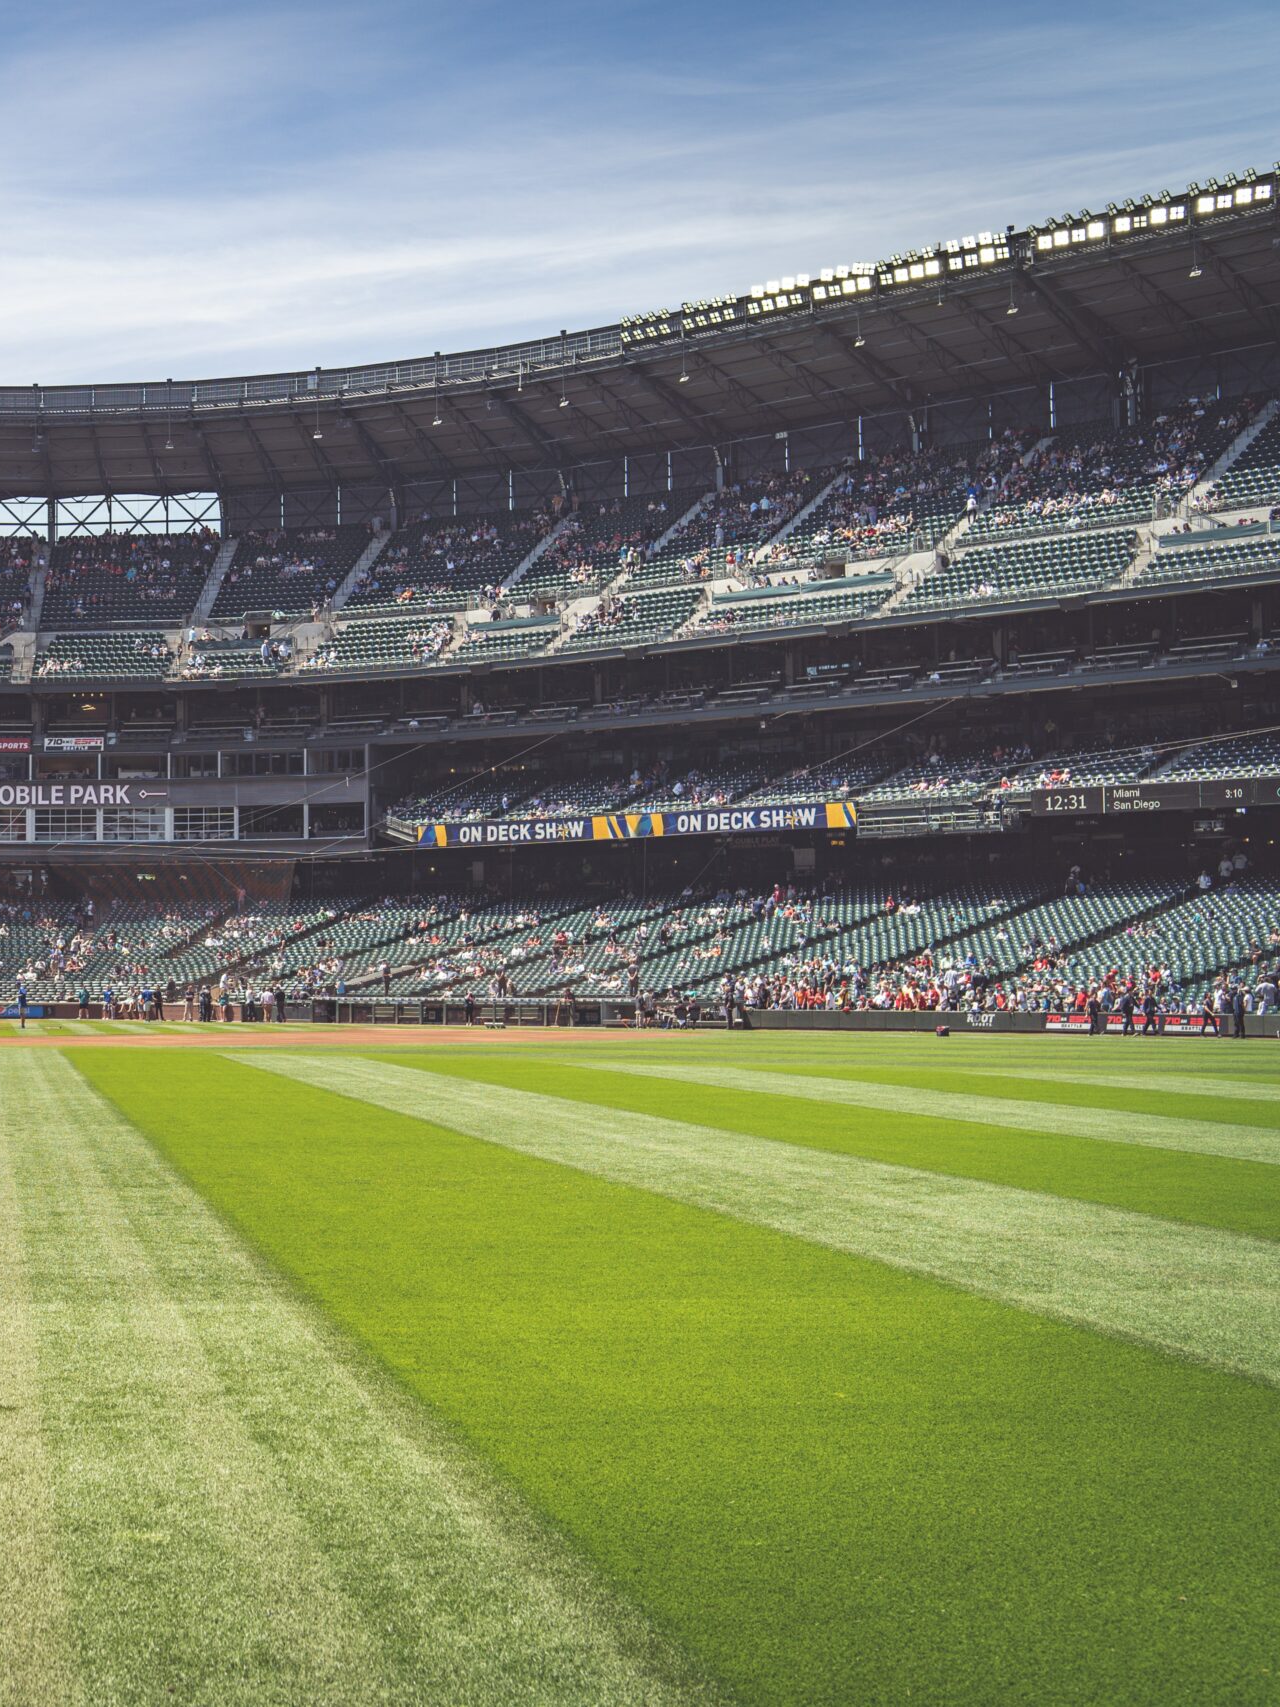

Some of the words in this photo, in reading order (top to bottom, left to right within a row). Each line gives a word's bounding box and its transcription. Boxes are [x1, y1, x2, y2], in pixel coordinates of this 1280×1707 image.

[70, 784, 131, 805] PARK
[1113, 787, 1140, 799] Miami
[1225, 788, 1243, 799] 3:10
[1045, 794, 1087, 811] 12:31
[1113, 801, 1131, 810] San
[1133, 800, 1160, 810] Diego
[678, 814, 702, 832] ON
[707, 812, 756, 830] DECK
[459, 826, 482, 843] ON
[486, 824, 531, 842] DECK
[966, 1013, 996, 1023] ROOT
[1047, 1015, 1061, 1023] 710
[1107, 1015, 1123, 1024] 710
[1165, 1016, 1181, 1025] 710
